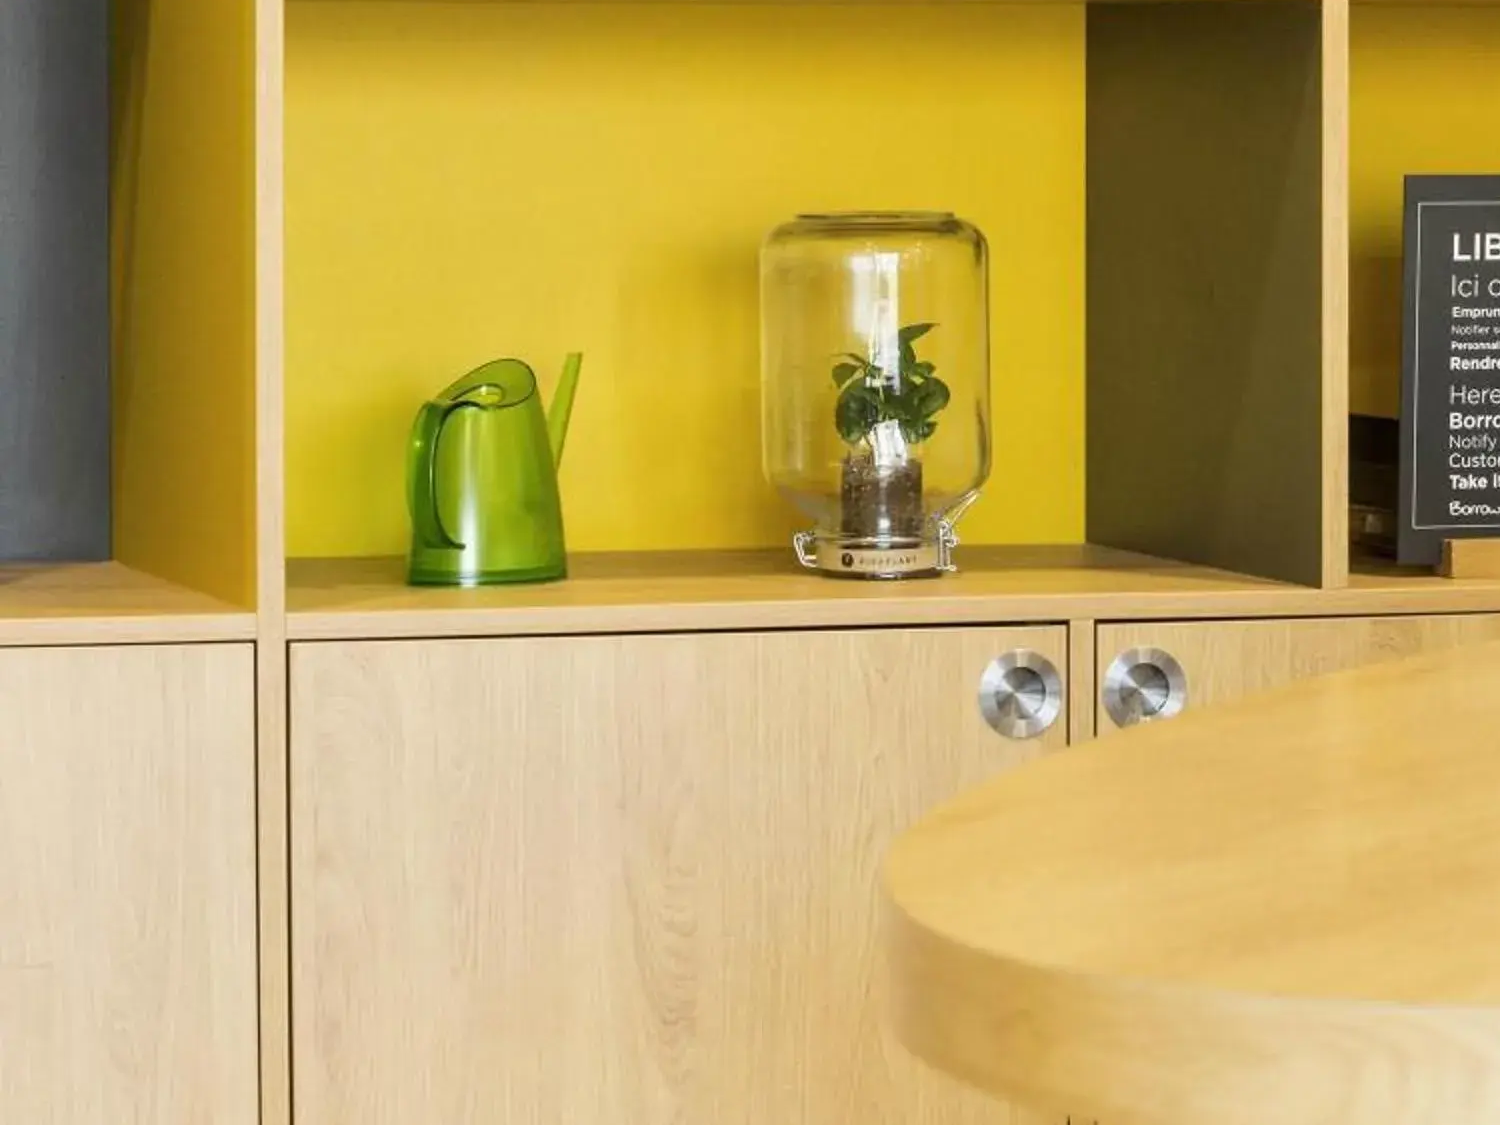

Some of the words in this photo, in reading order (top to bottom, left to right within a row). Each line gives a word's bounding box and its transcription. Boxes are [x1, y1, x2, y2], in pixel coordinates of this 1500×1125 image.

[1451, 274, 1479, 297] Ici
[1451, 324, 1490, 335] Notifier
[1449, 434, 1496, 452] Notify
[1449, 473, 1488, 490] Take
